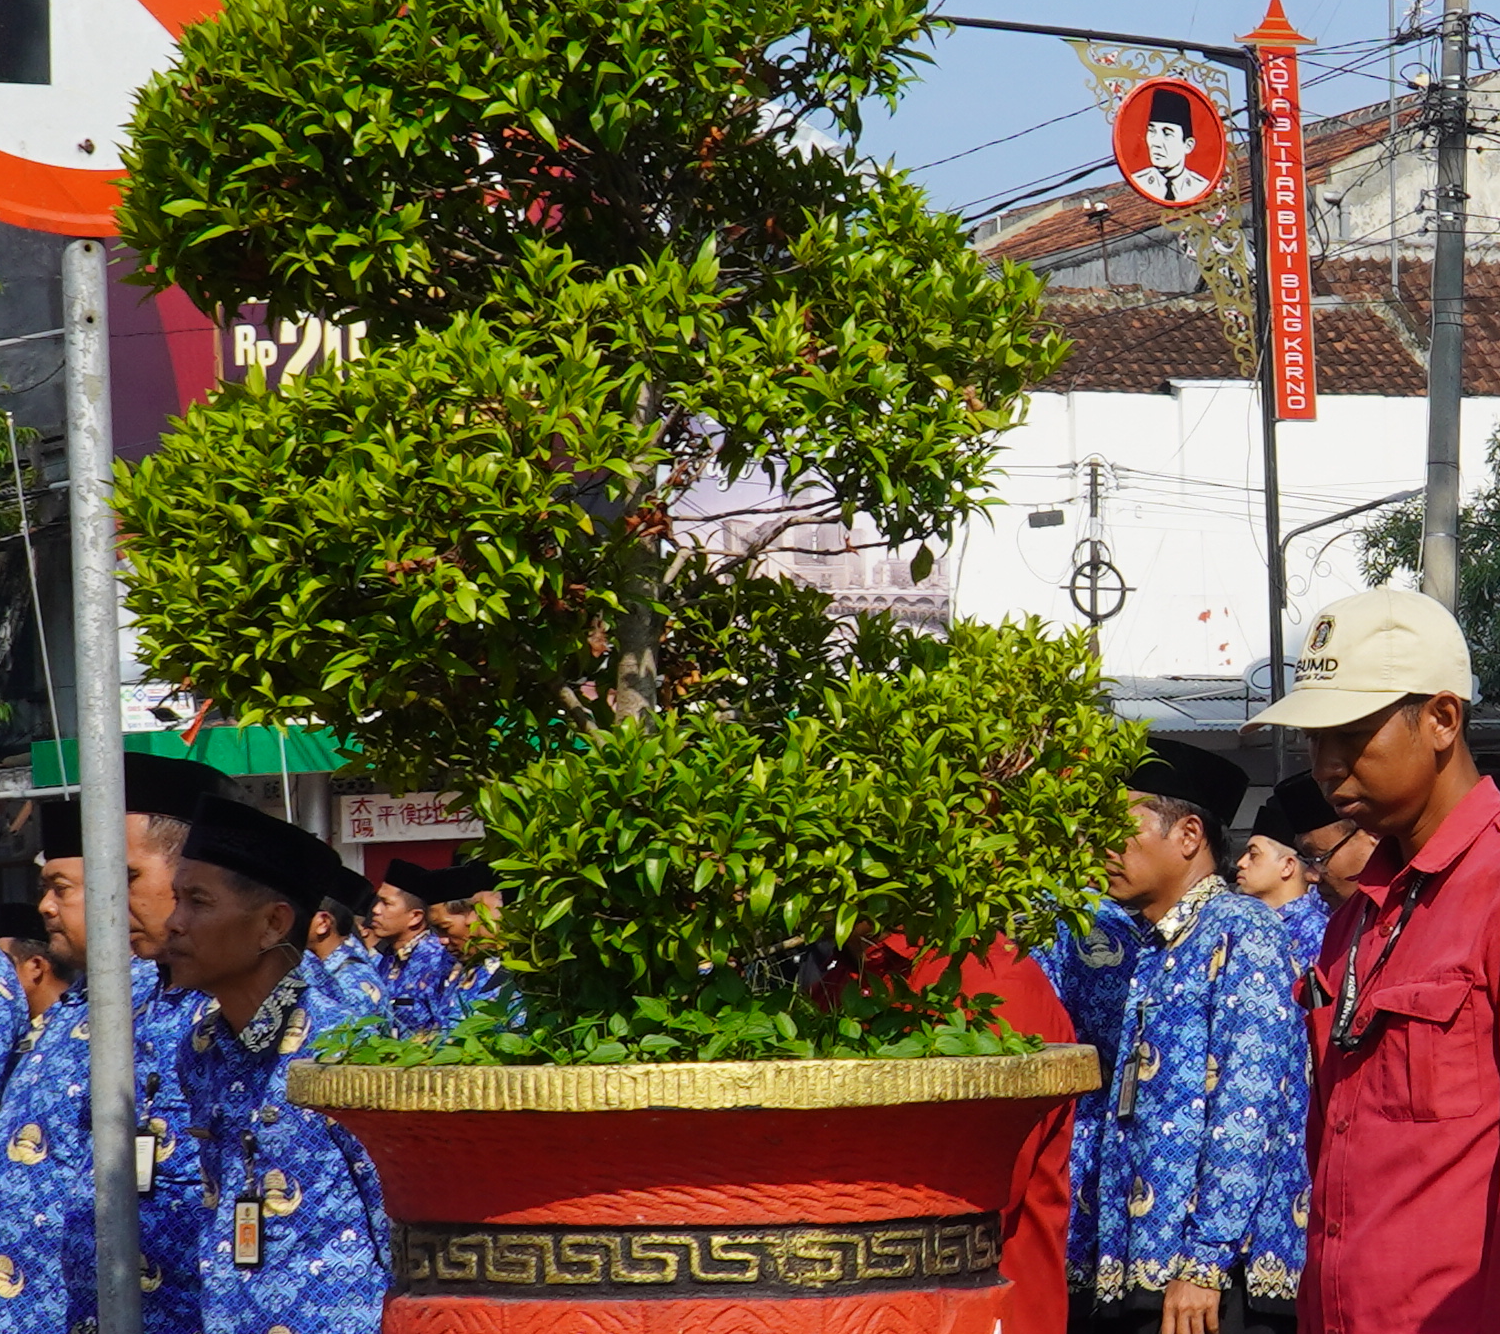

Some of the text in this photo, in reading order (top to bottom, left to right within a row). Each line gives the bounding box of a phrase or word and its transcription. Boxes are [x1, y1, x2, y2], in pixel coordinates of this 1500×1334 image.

[1268, 54, 1307, 410] KOTA BLITAR BUMI BUNG KARNO
